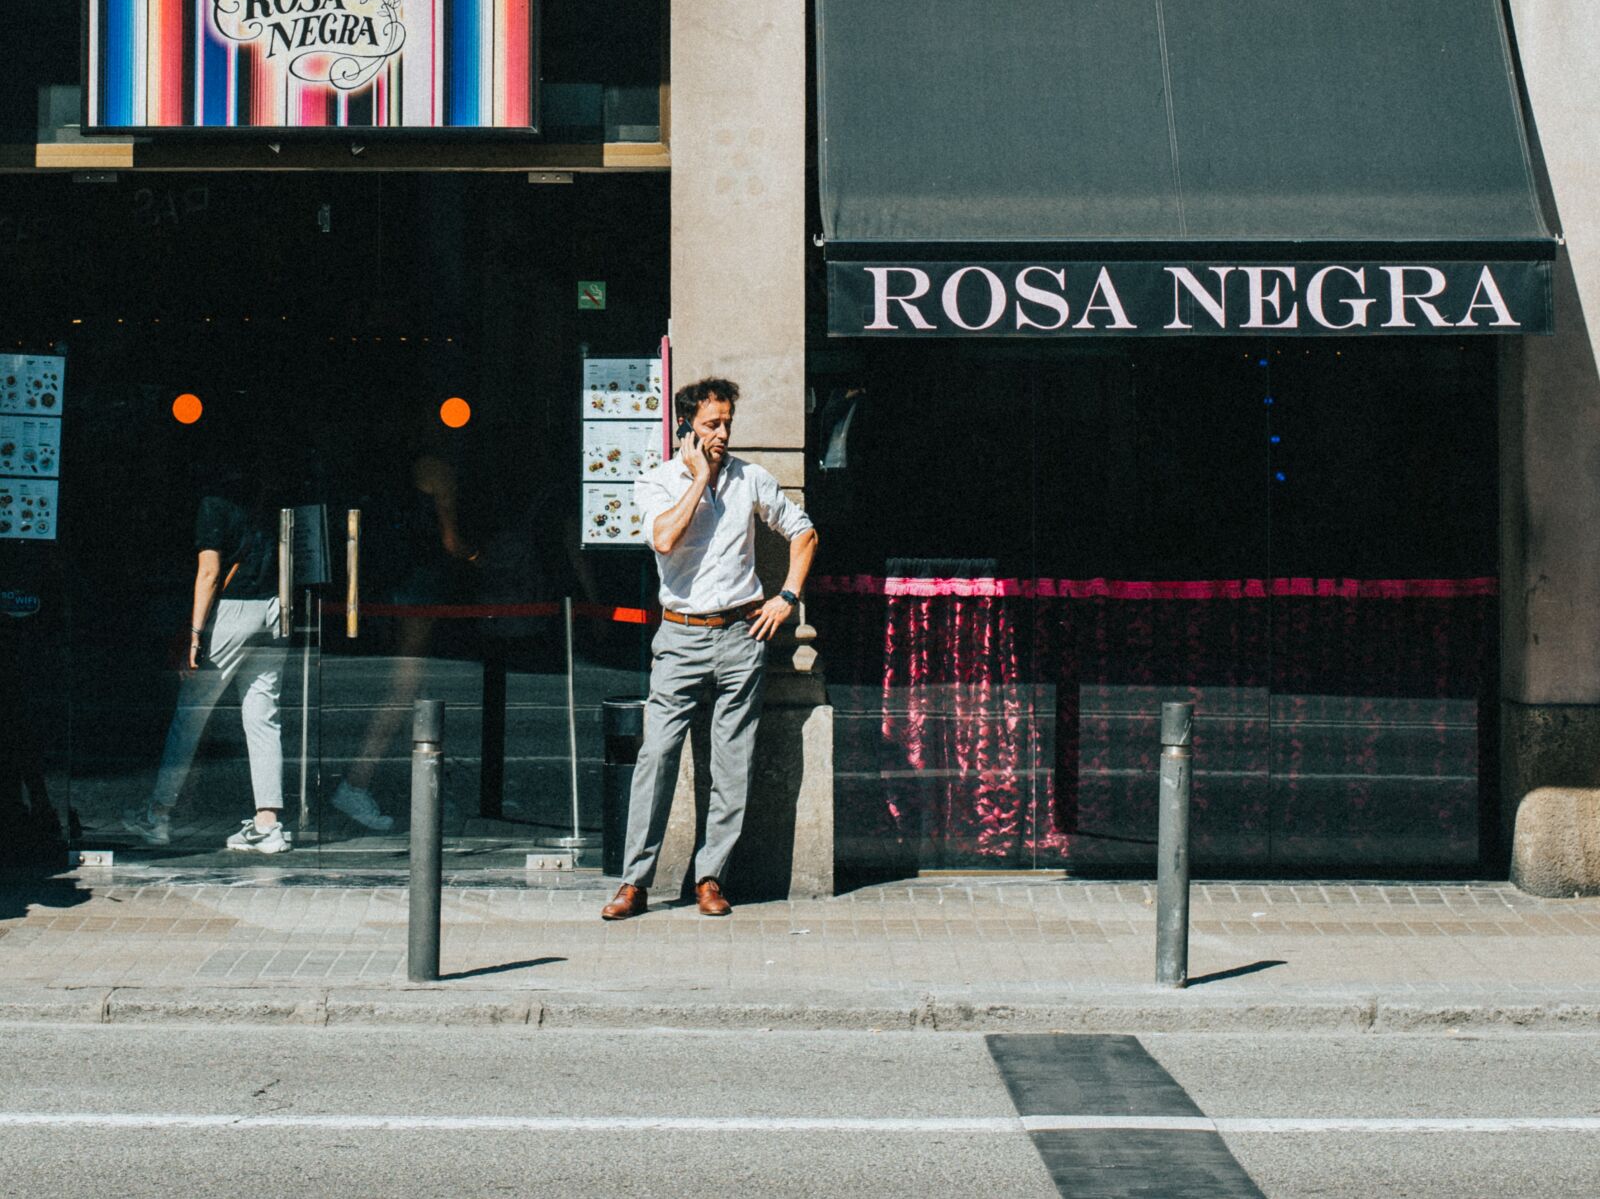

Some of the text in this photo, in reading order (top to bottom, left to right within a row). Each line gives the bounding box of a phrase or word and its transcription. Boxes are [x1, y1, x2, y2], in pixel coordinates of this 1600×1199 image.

[266, 12, 379, 58] NEGRA
[863, 265, 1521, 330] ROSA NEGRA
